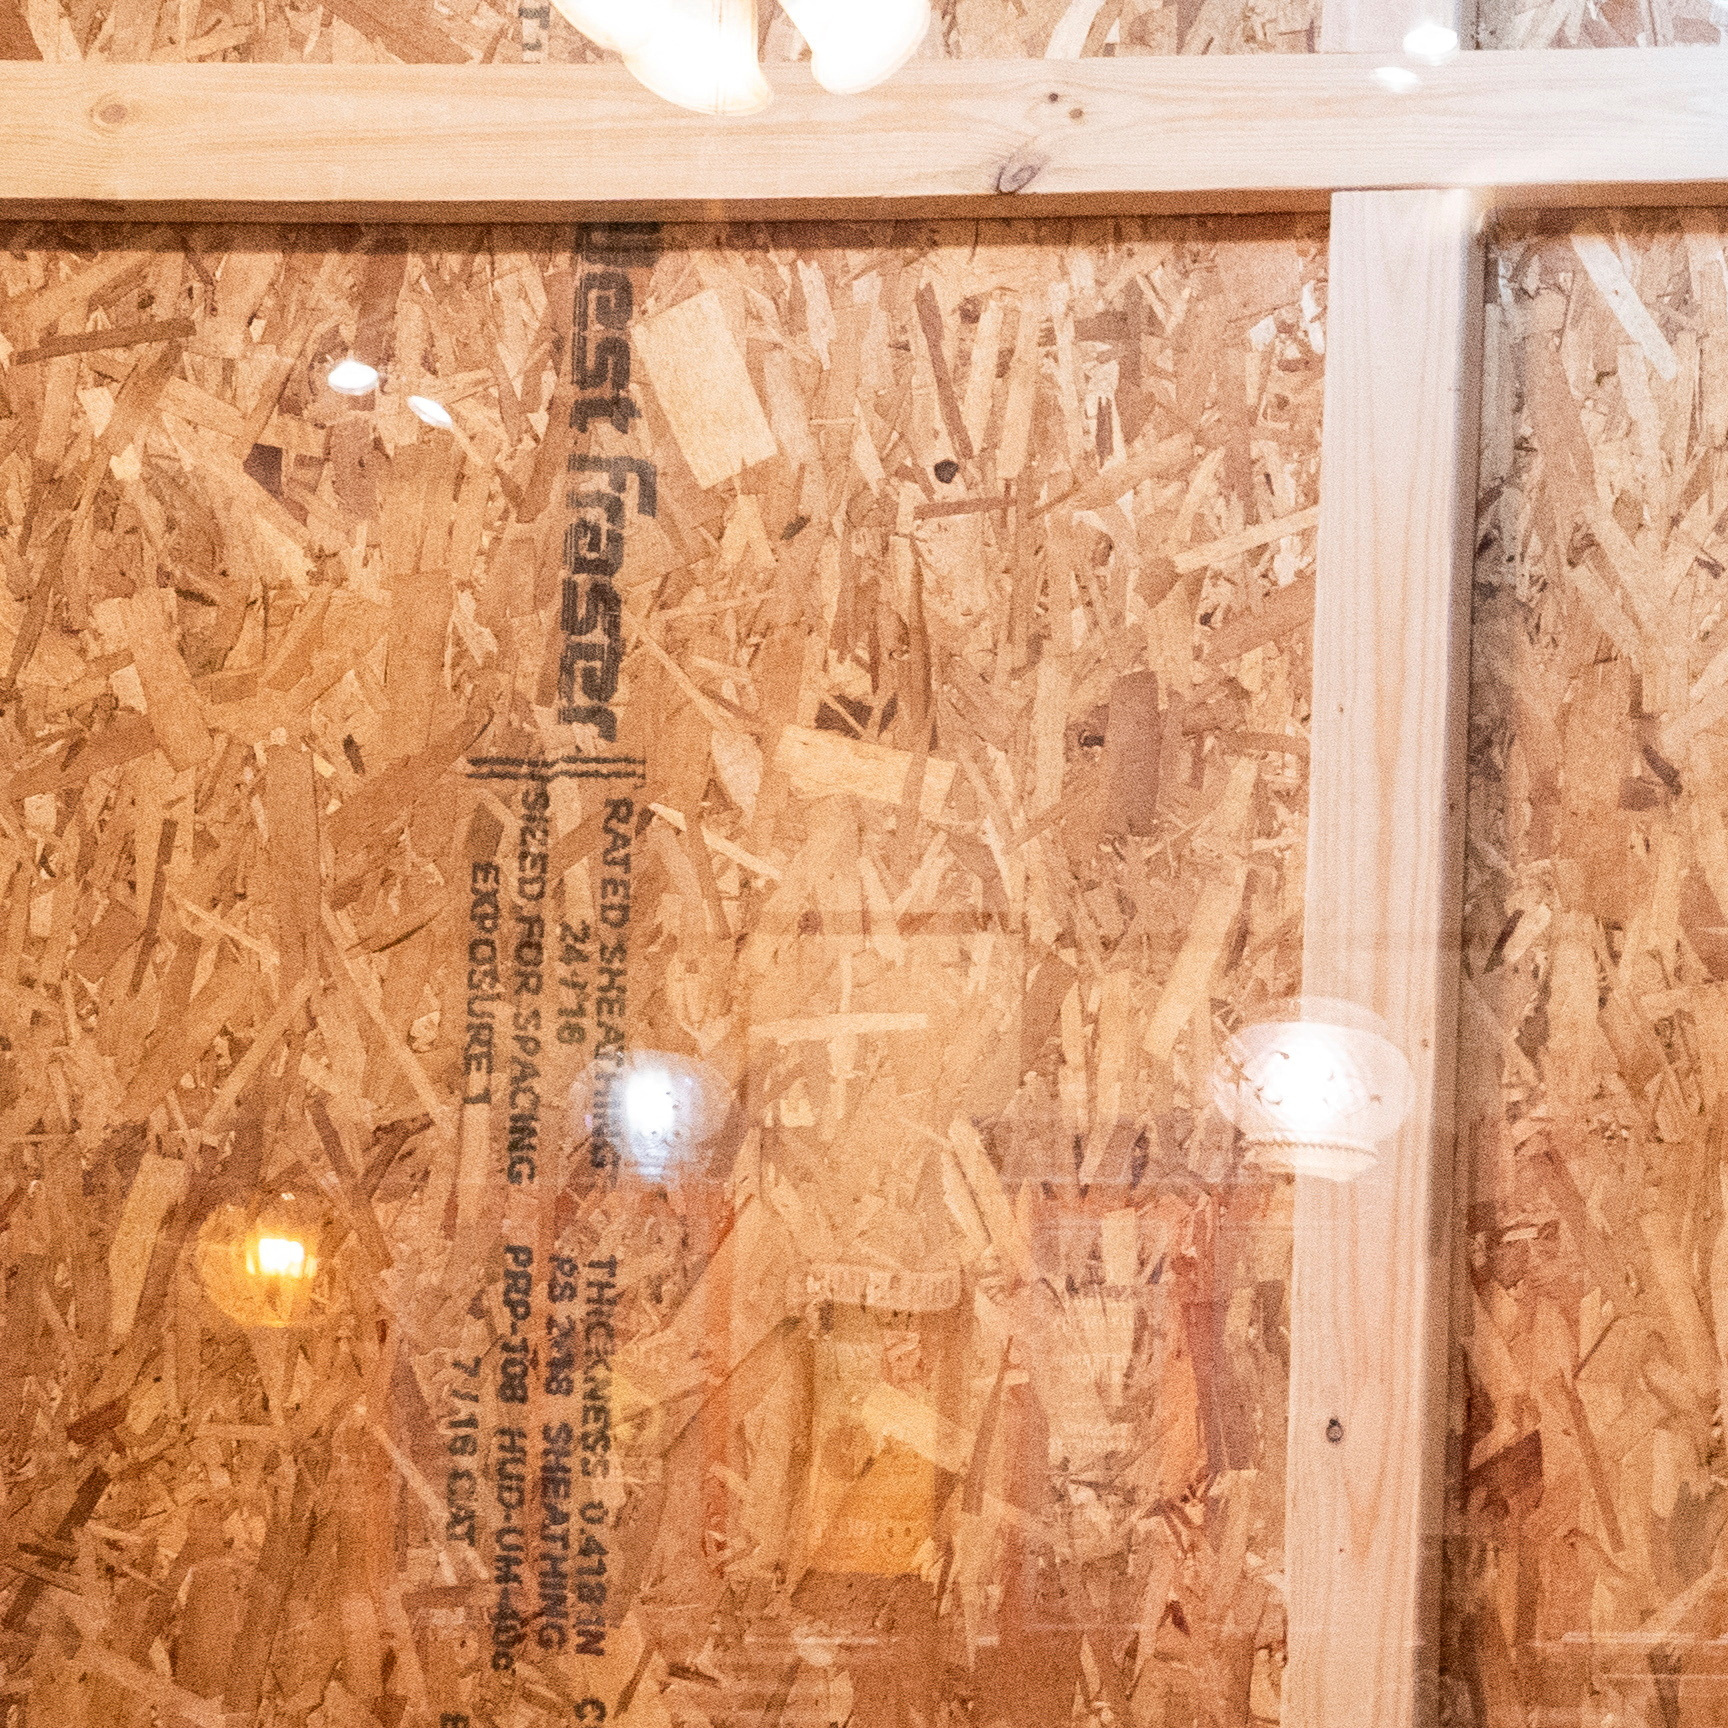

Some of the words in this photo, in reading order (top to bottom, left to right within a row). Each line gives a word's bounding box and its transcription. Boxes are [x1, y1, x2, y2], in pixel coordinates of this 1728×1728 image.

[558, 452, 658, 744] Fraser
[518, 790, 551, 902] SIZED
[600, 797, 633, 928] RATED
[464, 861, 500, 1076] EXPOSURE
[514, 914, 545, 996] FOR
[506, 1009, 541, 1185] SPACING
[589, 942, 627, 1170] SHEATHING
[499, 1244, 532, 1405] PRP-108
[547, 1254, 578, 1302] PS
[580, 1254, 617, 1479] THICKNESS
[446, 1468, 477, 1547] CAT
[537, 1422, 573, 1651] SHEATHING
